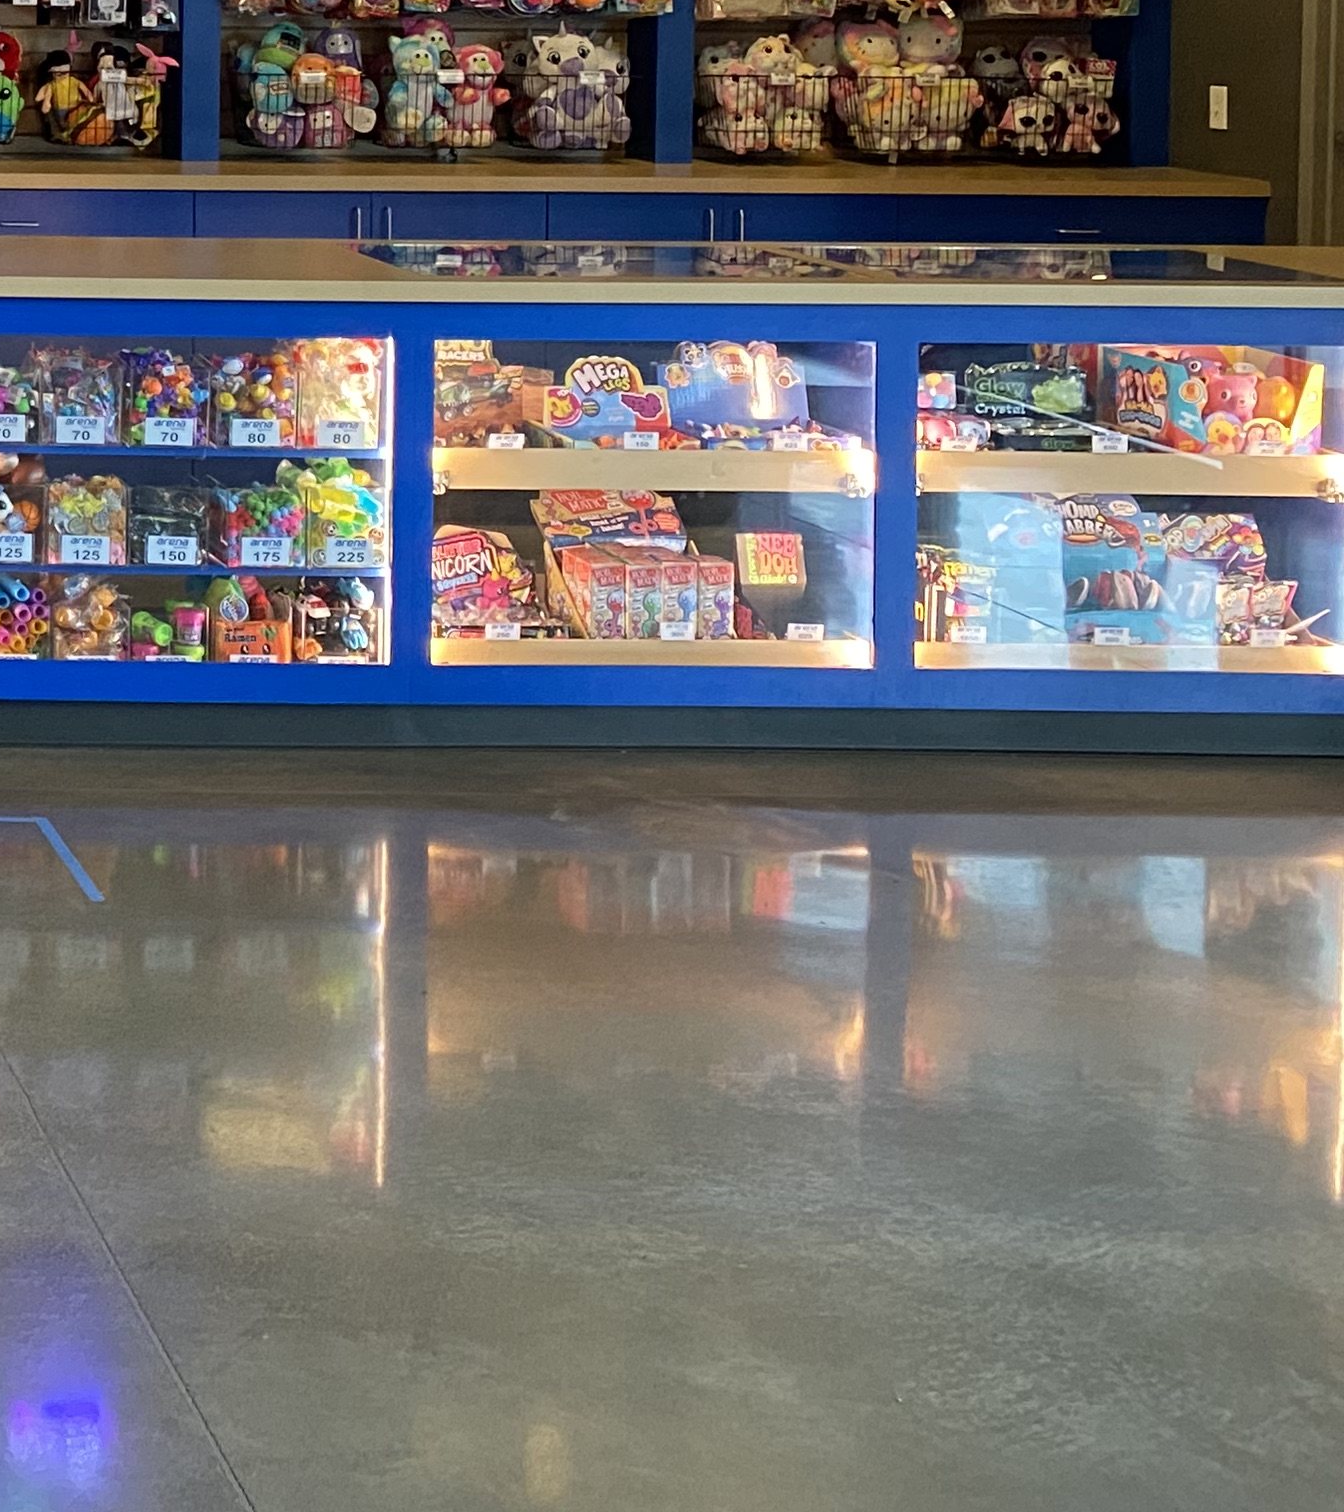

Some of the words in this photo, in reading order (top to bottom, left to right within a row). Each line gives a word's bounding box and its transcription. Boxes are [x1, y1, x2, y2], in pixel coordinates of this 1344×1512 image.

[437, 350, 486, 361] RACERS
[573, 361, 630, 393] MEGA
[975, 377, 1026, 393] Glow
[975, 402, 1027, 417] Crystal
[65, 417, 98, 426] arena
[154, 419, 187, 428] arena
[241, 420, 274, 429] arena
[326, 420, 359, 429] arena
[71, 430, 90, 441] 70
[160, 432, 179, 442] 70
[247, 433, 266, 443] 80
[332, 433, 351, 444] 80
[1041, 439, 1074, 449] Glow
[70, 537, 103, 546] arena
[156, 538, 189, 547] arena
[249, 538, 282, 547] arena
[335, 539, 368, 548] arena
[758, 533, 796, 558] NEE
[72, 550, 100, 560] 125
[159, 551, 187, 561] 150
[253, 551, 281, 562] 175
[337, 552, 365, 563] 225
[432, 548, 494, 581] NICORN
[758, 550, 798, 575] DOH
[224, 632, 257, 643] Ramen
